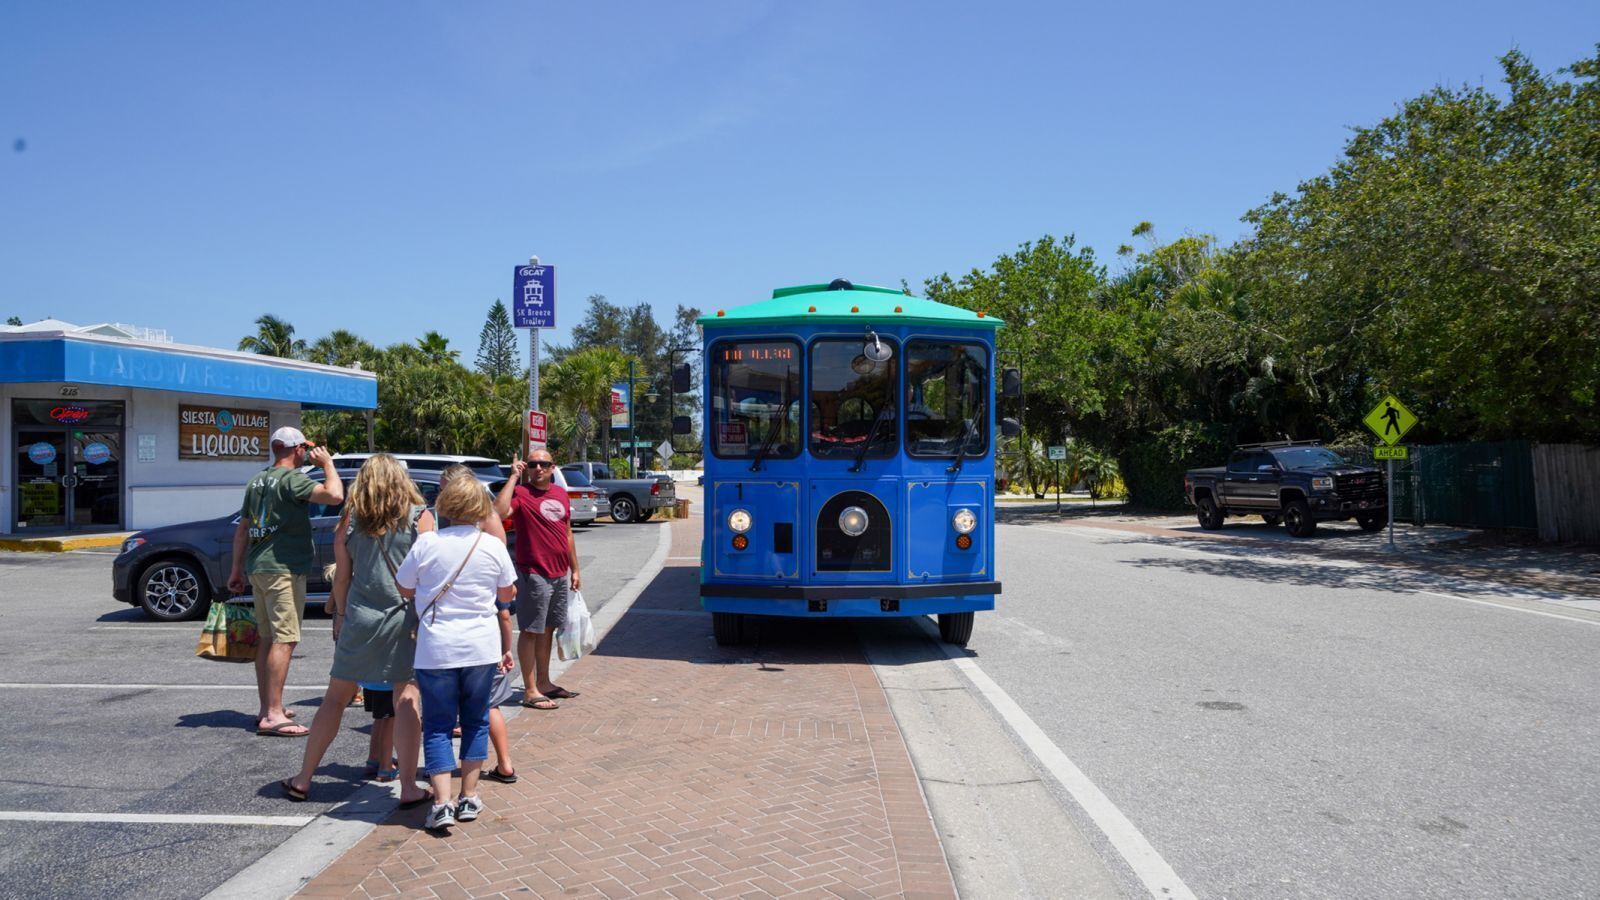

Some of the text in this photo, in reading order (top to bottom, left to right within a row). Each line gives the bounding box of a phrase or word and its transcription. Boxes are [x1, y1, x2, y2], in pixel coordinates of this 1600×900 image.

[528, 308, 551, 316] Breeze
[50, 407, 90, 419] Open
[181, 410, 269, 428] SIESTA VILLAGE
[192, 433, 260, 457] LIQUORS
[1378, 448, 1403, 457] AHEAD
